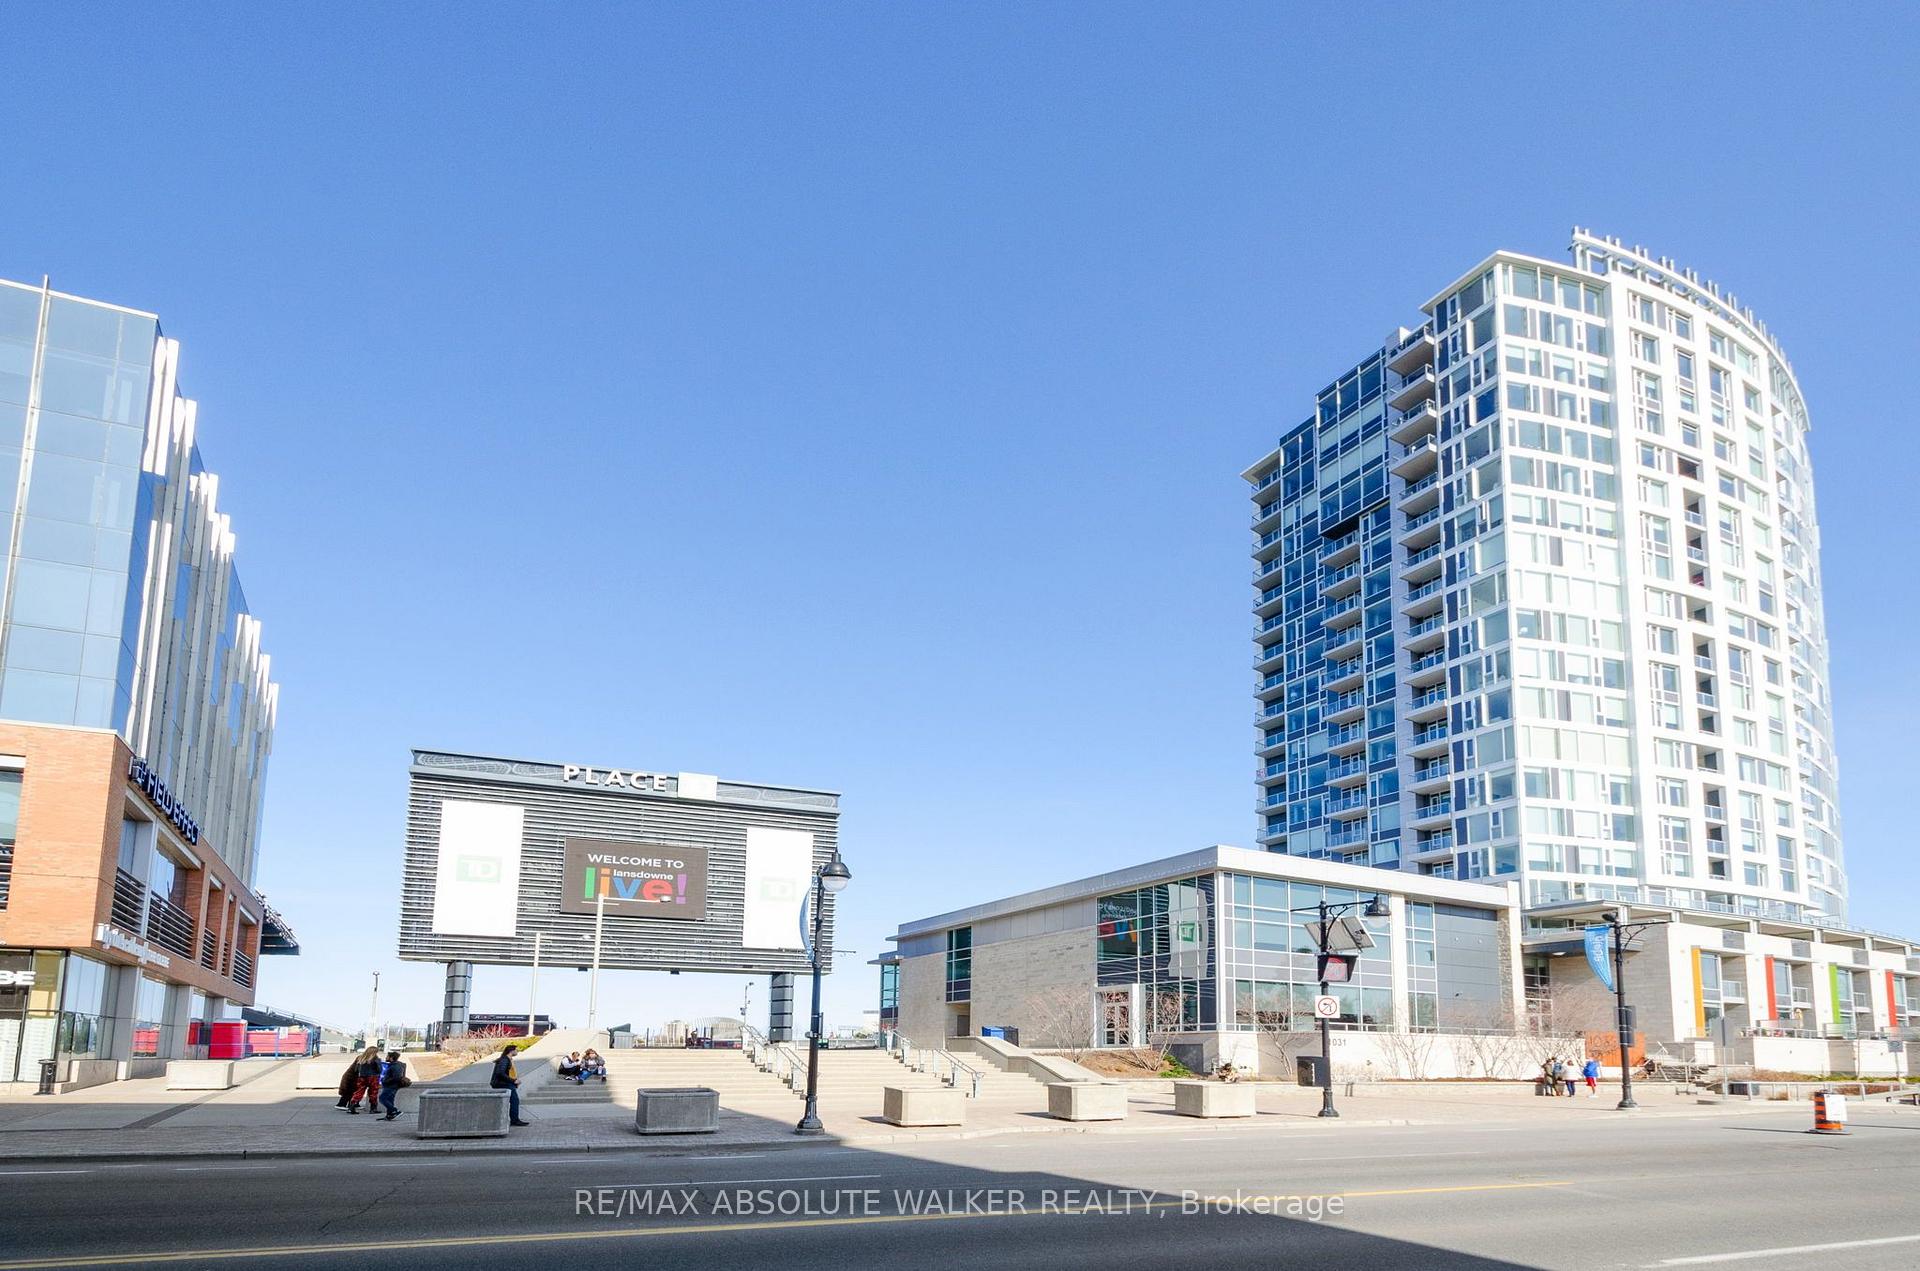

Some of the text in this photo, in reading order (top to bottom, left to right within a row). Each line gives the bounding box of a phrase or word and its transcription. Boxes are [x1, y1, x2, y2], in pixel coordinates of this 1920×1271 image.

[563, 765, 668, 791] PLACE
[148, 769, 201, 846] FIELD EFFECT
[587, 853, 685, 869] WELCOME TO
[584, 866, 687, 905] live!
